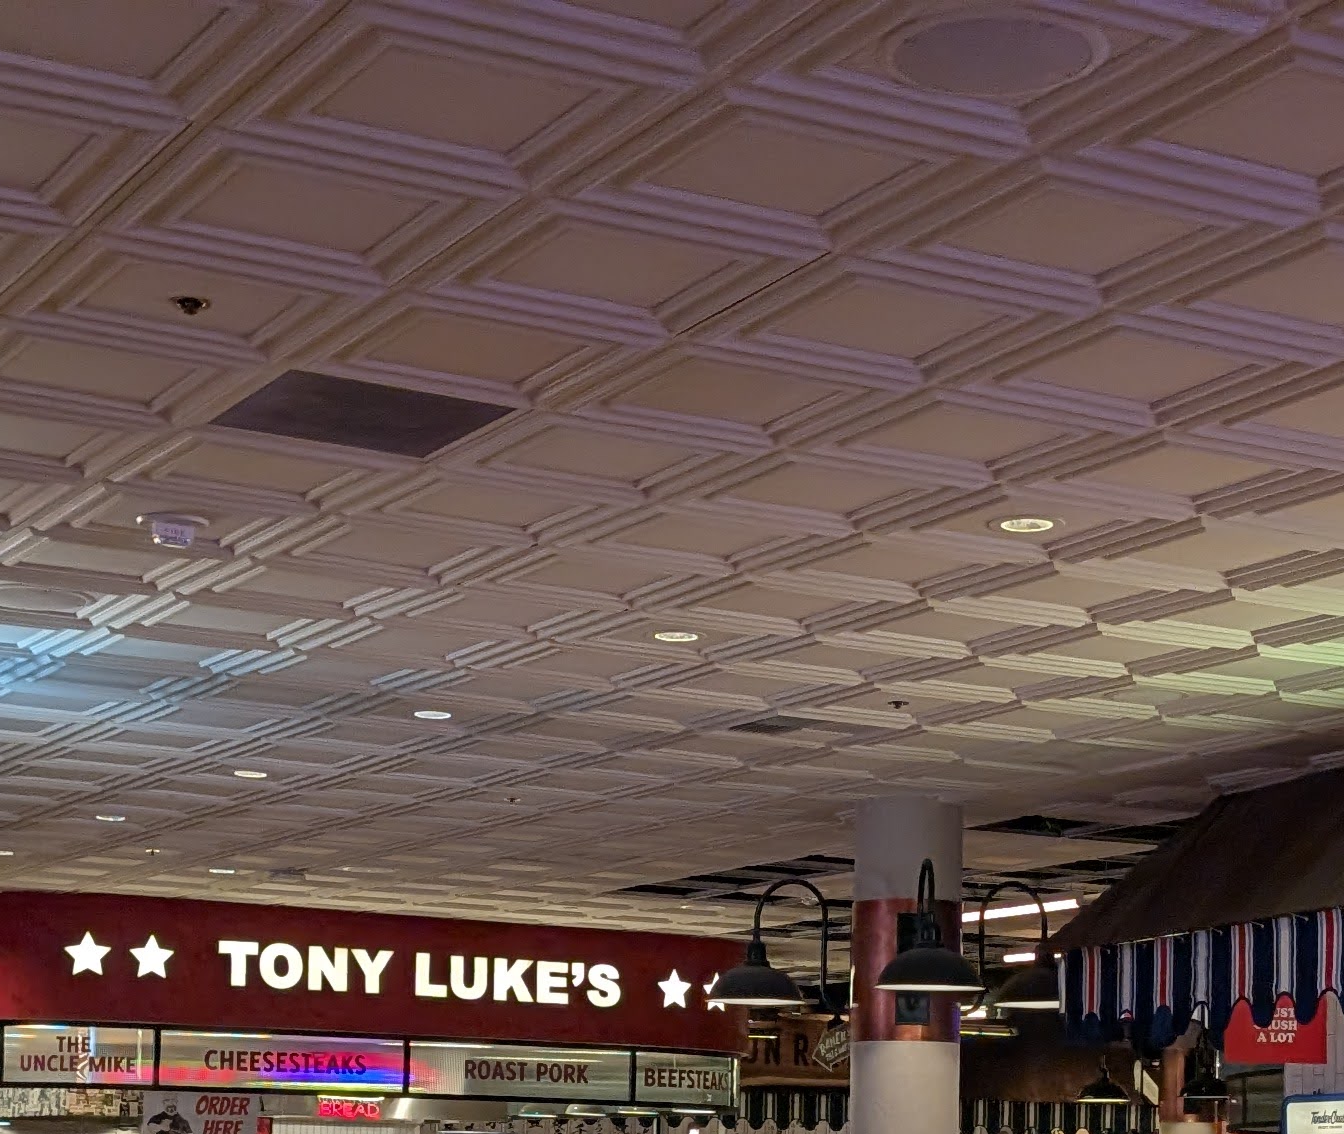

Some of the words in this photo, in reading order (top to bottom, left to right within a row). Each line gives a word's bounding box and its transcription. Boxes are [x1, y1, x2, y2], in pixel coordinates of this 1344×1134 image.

[218, 940, 394, 994] TONY
[415, 952, 622, 1007] LUKE'S
[56, 1036, 91, 1053] THE
[1257, 1032, 1267, 1043] A
[1270, 1032, 1295, 1043] LOT
[20, 1054, 79, 1072] UNCLE
[89, 1056, 136, 1074] MIKE
[204, 1050, 367, 1075] CHEESESTEAKS
[464, 1060, 528, 1082] ROAST
[536, 1063, 589, 1084] PORK
[644, 1067, 729, 1091] BEEFSTEAKS
[196, 1096, 250, 1116] ORDER
[320, 1102, 380, 1118] BREAD
